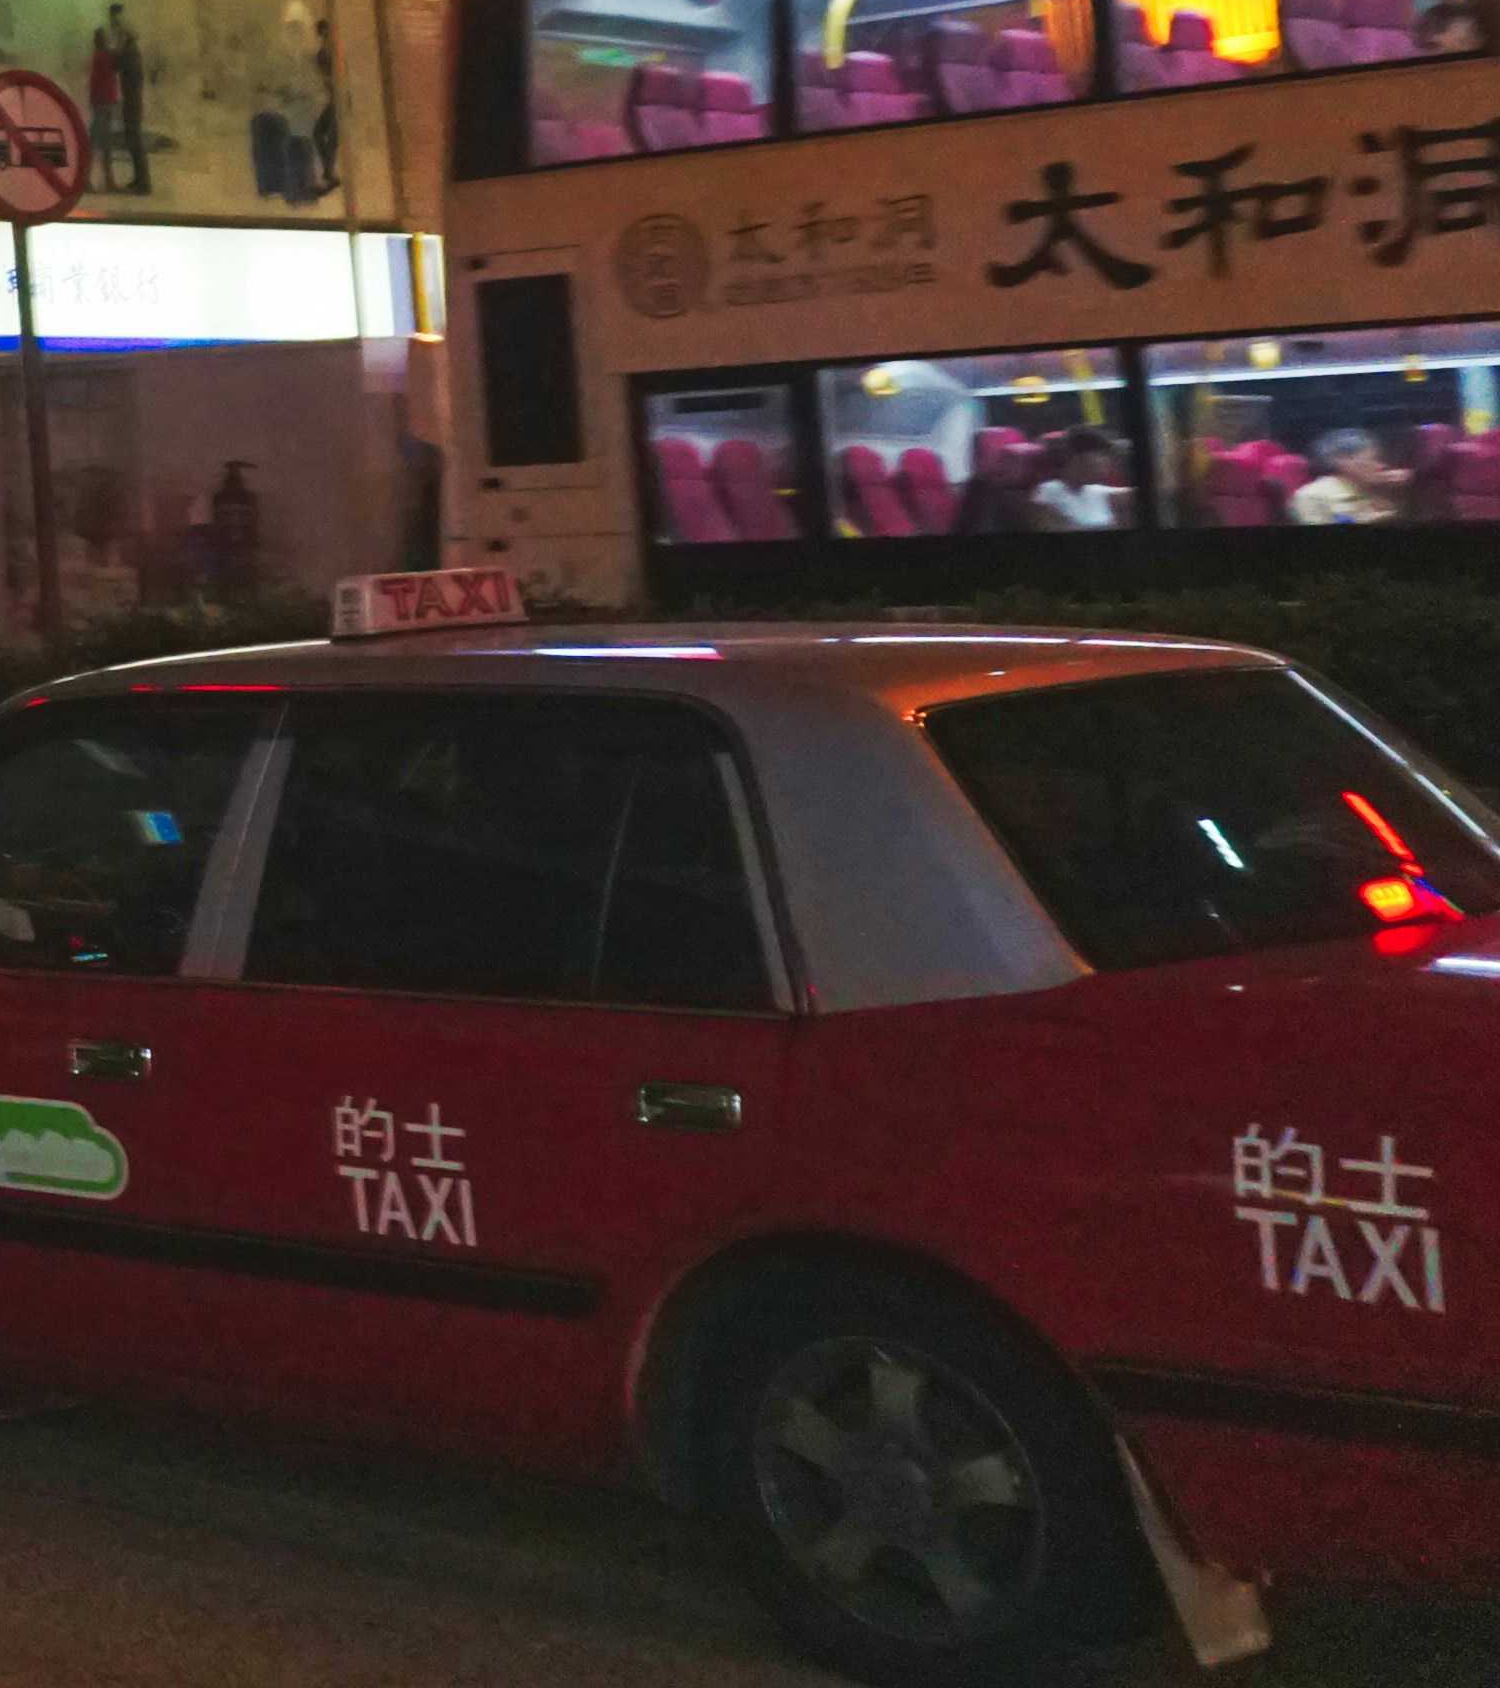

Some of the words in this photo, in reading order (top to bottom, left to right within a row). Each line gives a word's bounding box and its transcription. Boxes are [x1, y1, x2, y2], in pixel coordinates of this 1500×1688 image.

[725, 194, 938, 264] 太和洞
[380, 569, 512, 621] TAXI
[334, 1095, 467, 1172] 的士
[1233, 1122, 1436, 1221] 的士
[336, 1164, 479, 1247] TAXI
[1234, 1205, 1448, 1313] TAXI
